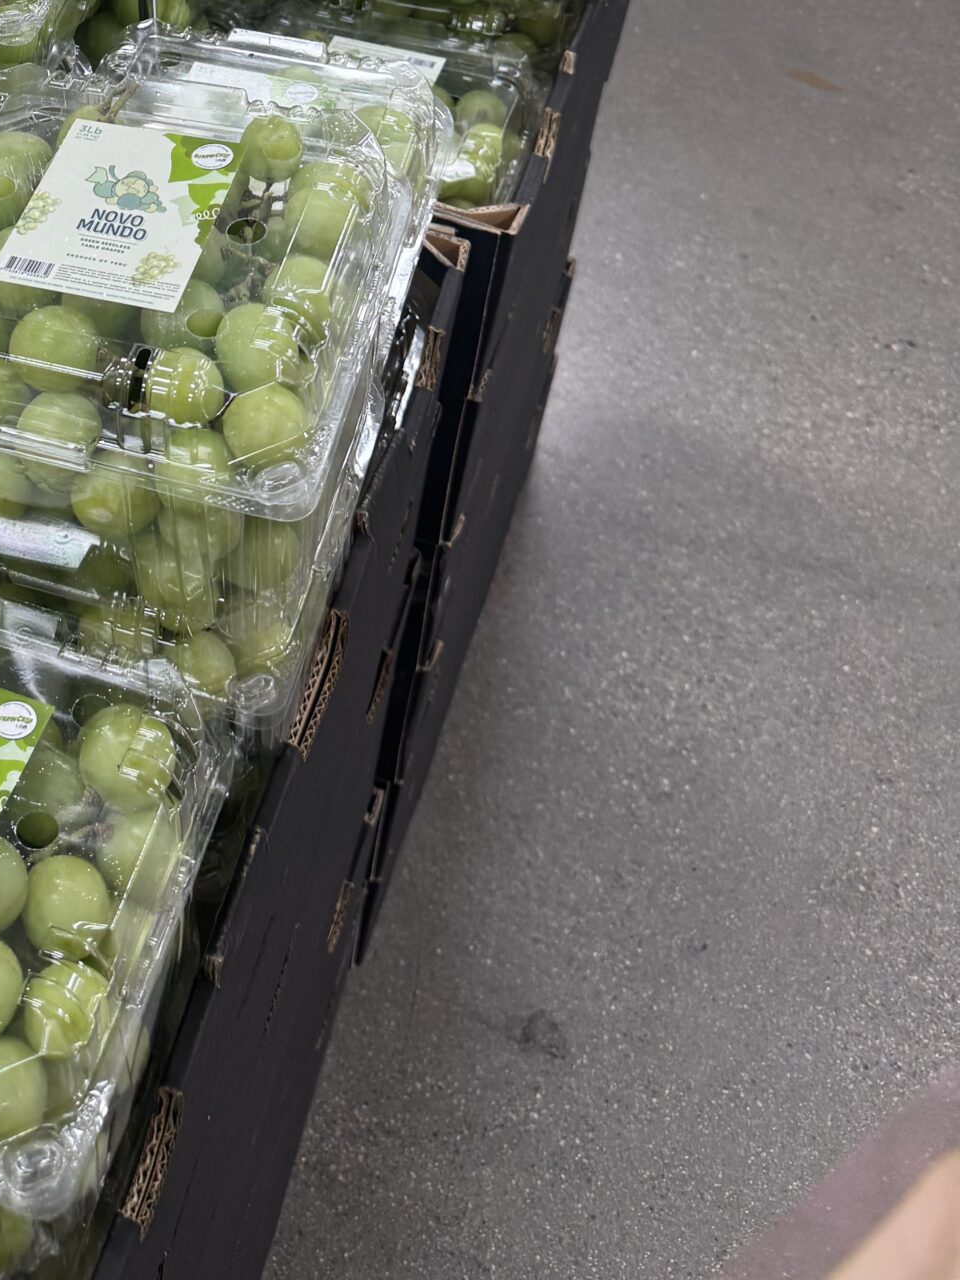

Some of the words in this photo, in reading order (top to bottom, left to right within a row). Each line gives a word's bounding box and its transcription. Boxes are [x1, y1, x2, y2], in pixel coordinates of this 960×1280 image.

[79, 124, 103, 136] 3Lb
[90, 207, 144, 228] NOVO
[76, 218, 148, 242] MUNDO
